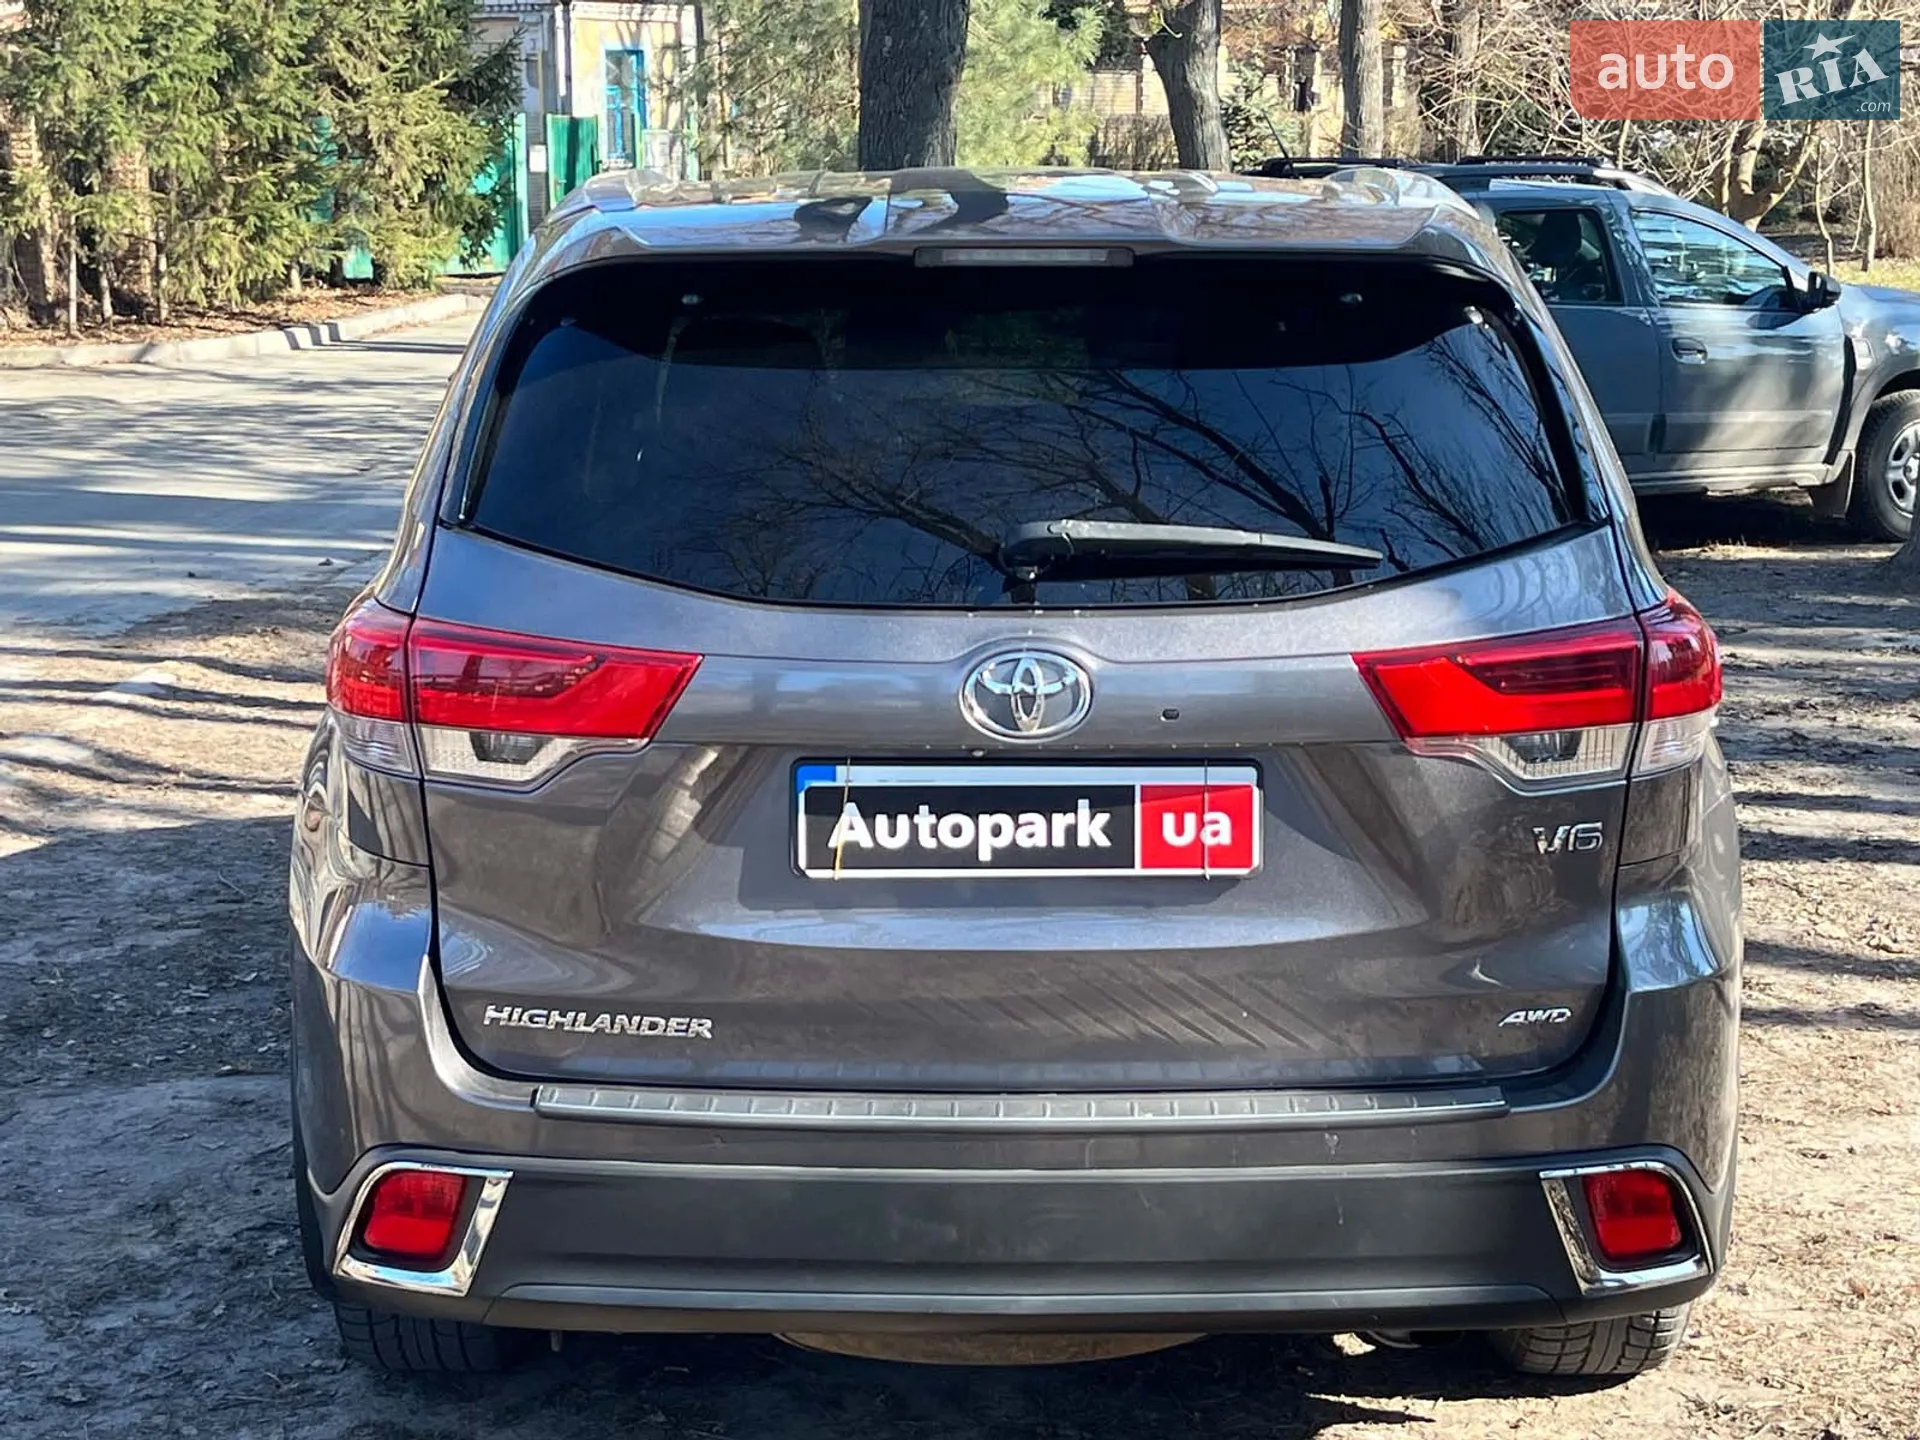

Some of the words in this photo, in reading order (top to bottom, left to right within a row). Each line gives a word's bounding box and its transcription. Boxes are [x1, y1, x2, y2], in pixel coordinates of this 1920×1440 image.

[827, 801, 1112, 862] Autopark
[1161, 810, 1232, 847] ua
[1532, 822, 1603, 854] V6
[483, 1004, 713, 1039] HIGHLANDER
[1499, 1007, 1572, 1027] AWD
